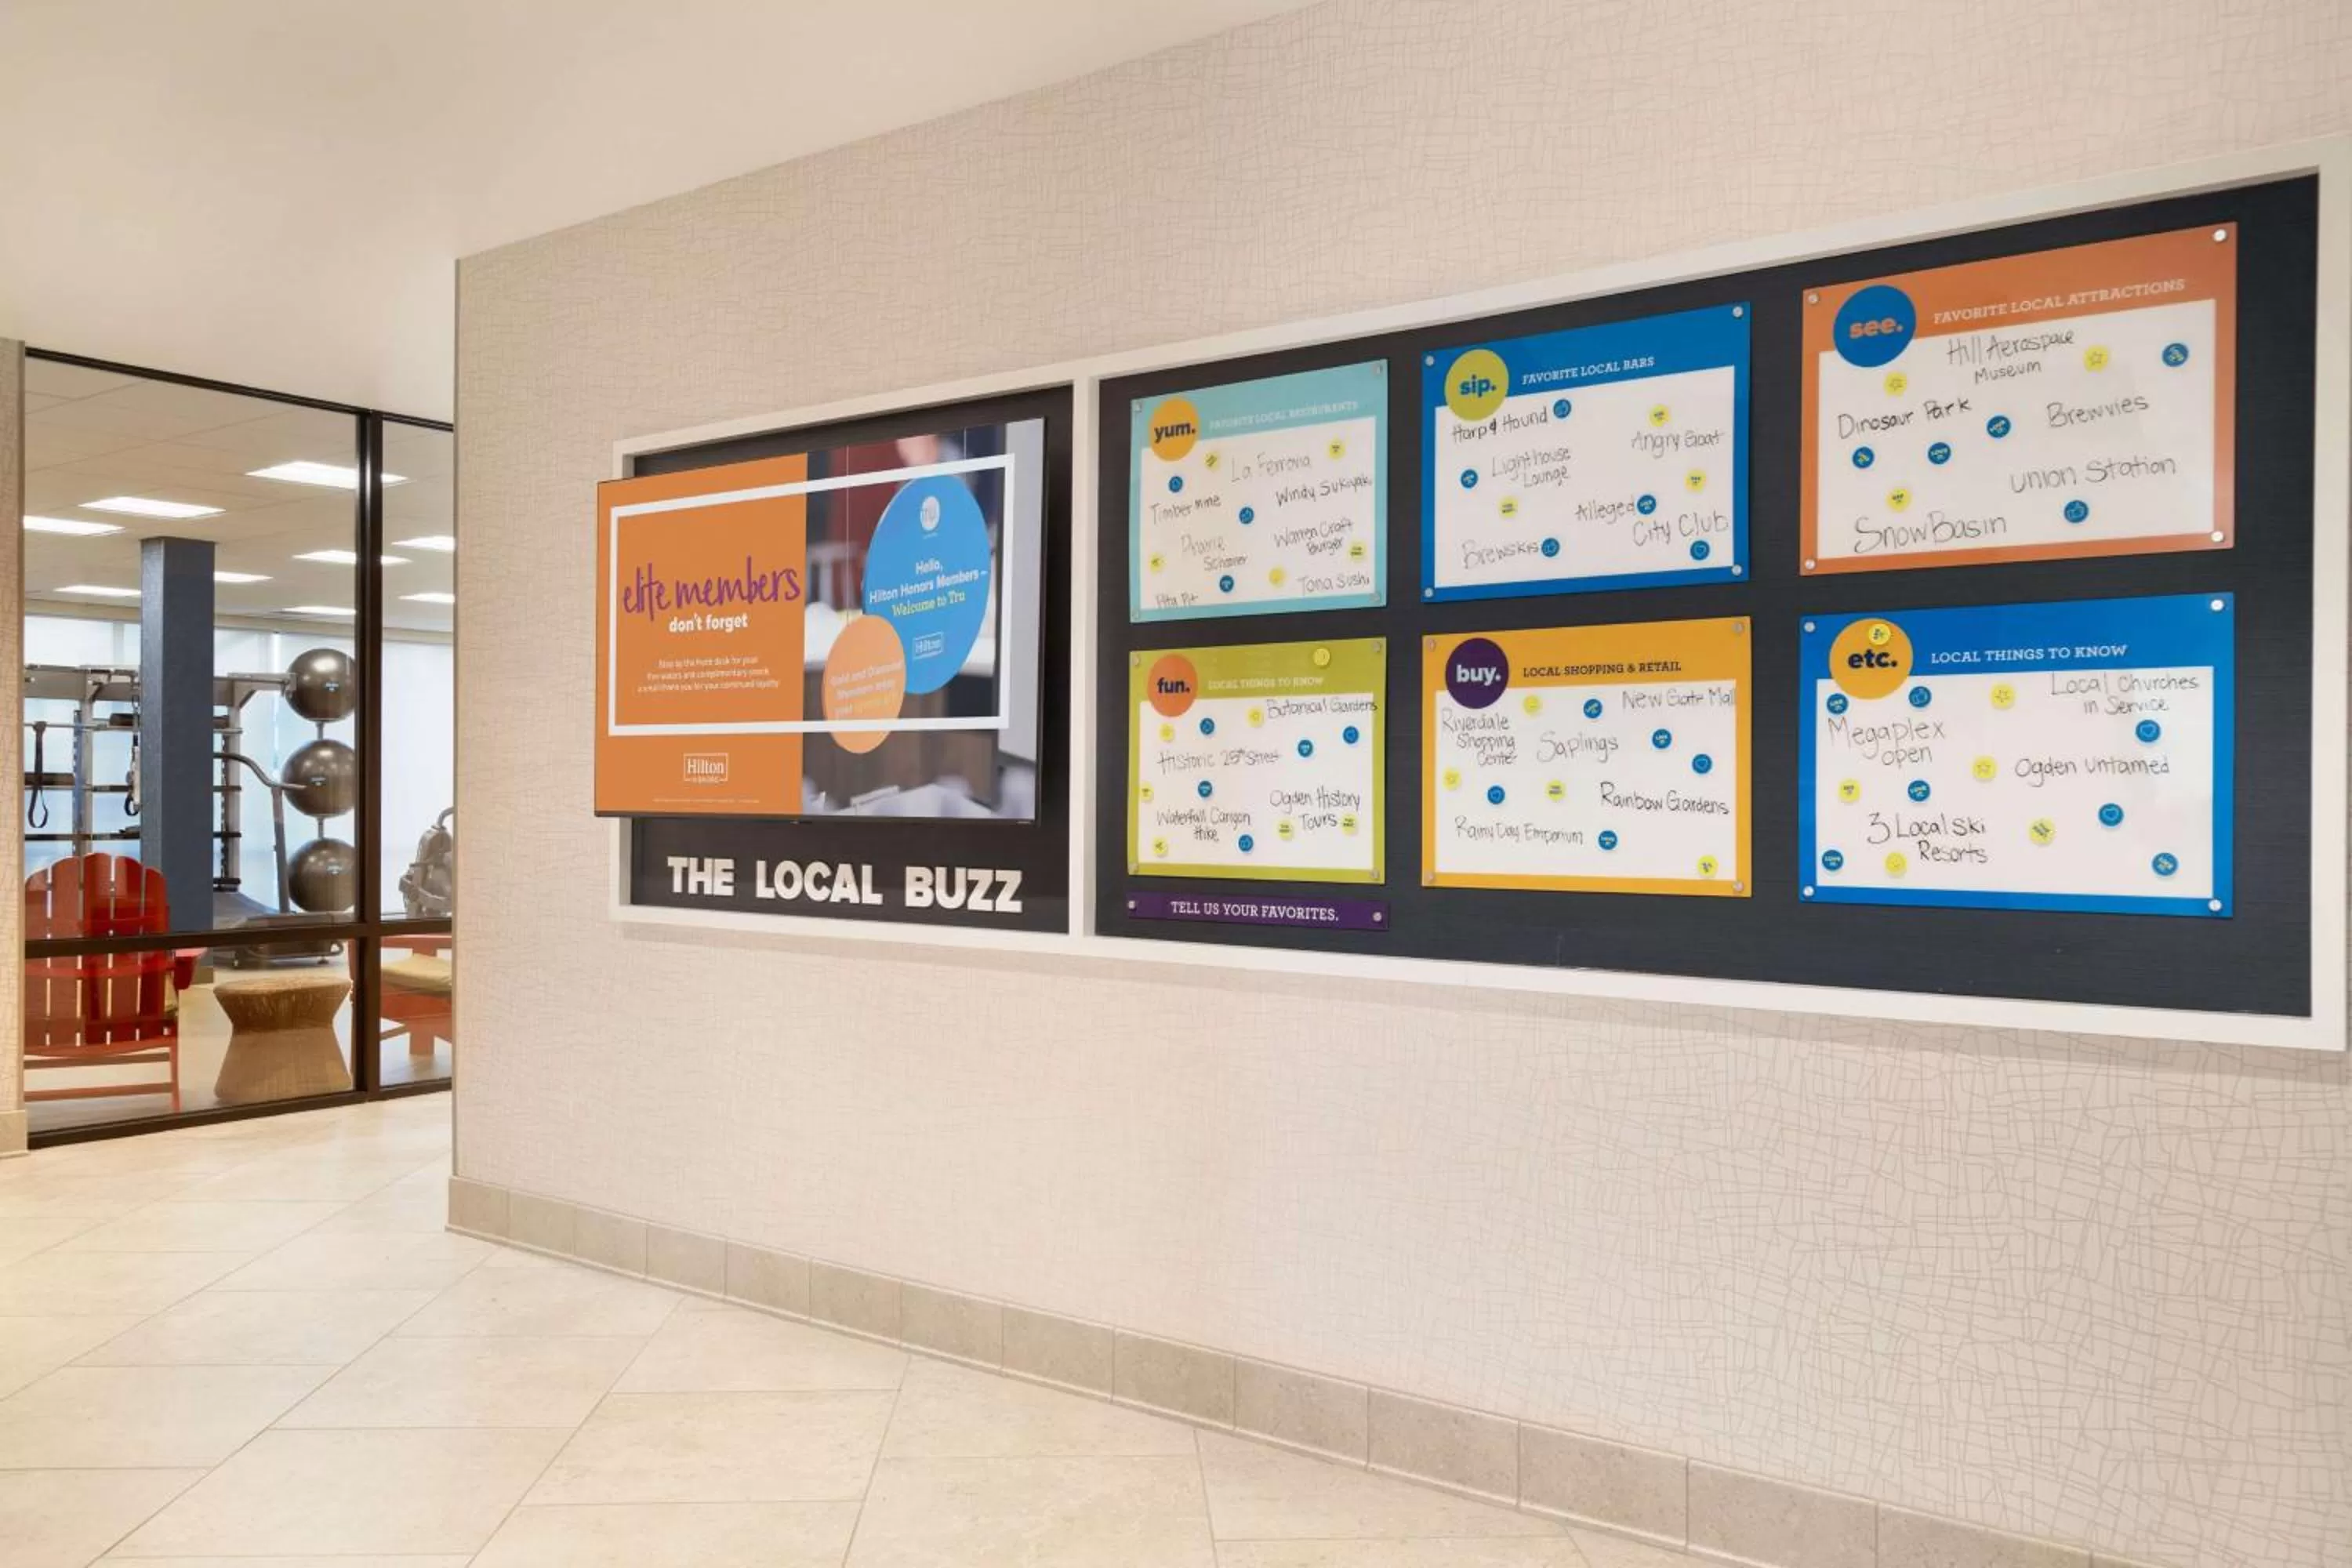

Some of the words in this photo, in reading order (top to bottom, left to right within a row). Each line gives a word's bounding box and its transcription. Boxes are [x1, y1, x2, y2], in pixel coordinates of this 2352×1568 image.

[1933, 303, 2008, 325] FAVORITE
[2010, 295, 2064, 314] LOCAL
[2066, 278, 2186, 307] ATTRACTIONS
[1849, 318, 1904, 339] see.
[1947, 338, 1984, 367] Hill
[1521, 367, 1578, 386] FAVORITE
[1580, 361, 1621, 377] LOCAL
[1622, 356, 1656, 372] BARS
[1974, 361, 2042, 384] Museum
[1458, 374, 1497, 397] sip.
[1452, 423, 1487, 445] Harp
[1502, 407, 1549, 431] Hound
[1837, 410, 1915, 441] Dinosaur
[1923, 397, 1973, 423] Park
[1153, 422, 1196, 444] yum.
[1231, 455, 1252, 483] La
[2085, 453, 2177, 485] Station
[1275, 484, 1316, 508] Windy
[1632, 520, 1671, 546] City
[1677, 509, 1730, 537] Club
[915, 557, 944, 575] Hello,
[674, 554, 801, 610] members
[869, 589, 898, 604] Hilton
[900, 579, 934, 597] Honors
[936, 568, 979, 589] Members
[891, 598, 936, 617] Welcome
[937, 594, 948, 608] to
[948, 590, 966, 604] Tru
[669, 612, 703, 633] don't
[705, 611, 749, 634] forget
[1847, 648, 1898, 670] etc.
[1931, 650, 1982, 665] LOCAL
[1984, 647, 2045, 662] THINGS
[2048, 645, 2071, 660] TO
[2074, 643, 2129, 659] KNOW
[1455, 664, 1502, 687] buy.
[1523, 666, 1561, 677] LOCAL
[1563, 663, 1624, 677] SHOPPING
[1626, 662, 1636, 673] &
[1638, 660, 1682, 673] RETAIL
[1156, 677, 1191, 695] fun.
[2049, 672, 2109, 697] Local
[1537, 730, 1620, 764] Saplings
[1827, 716, 1947, 760] Megaplex
[687, 757, 724, 775] Hilton
[1880, 743, 1933, 770] open
[2013, 756, 2078, 789] Ogden
[1599, 781, 1664, 812] Rainbow
[1666, 789, 1730, 816] Gardens
[1866, 812, 1892, 844] 3
[1918, 840, 1988, 865] Resorts
[666, 855, 735, 897] THE
[755, 859, 884, 906] LOCAL
[904, 865, 1023, 913] BUZZ
[1170, 901, 1201, 915] TELL
[1203, 902, 1221, 916] US
[1221, 903, 1259, 918] YOUR
[1261, 905, 1340, 922] FAVORITES.
